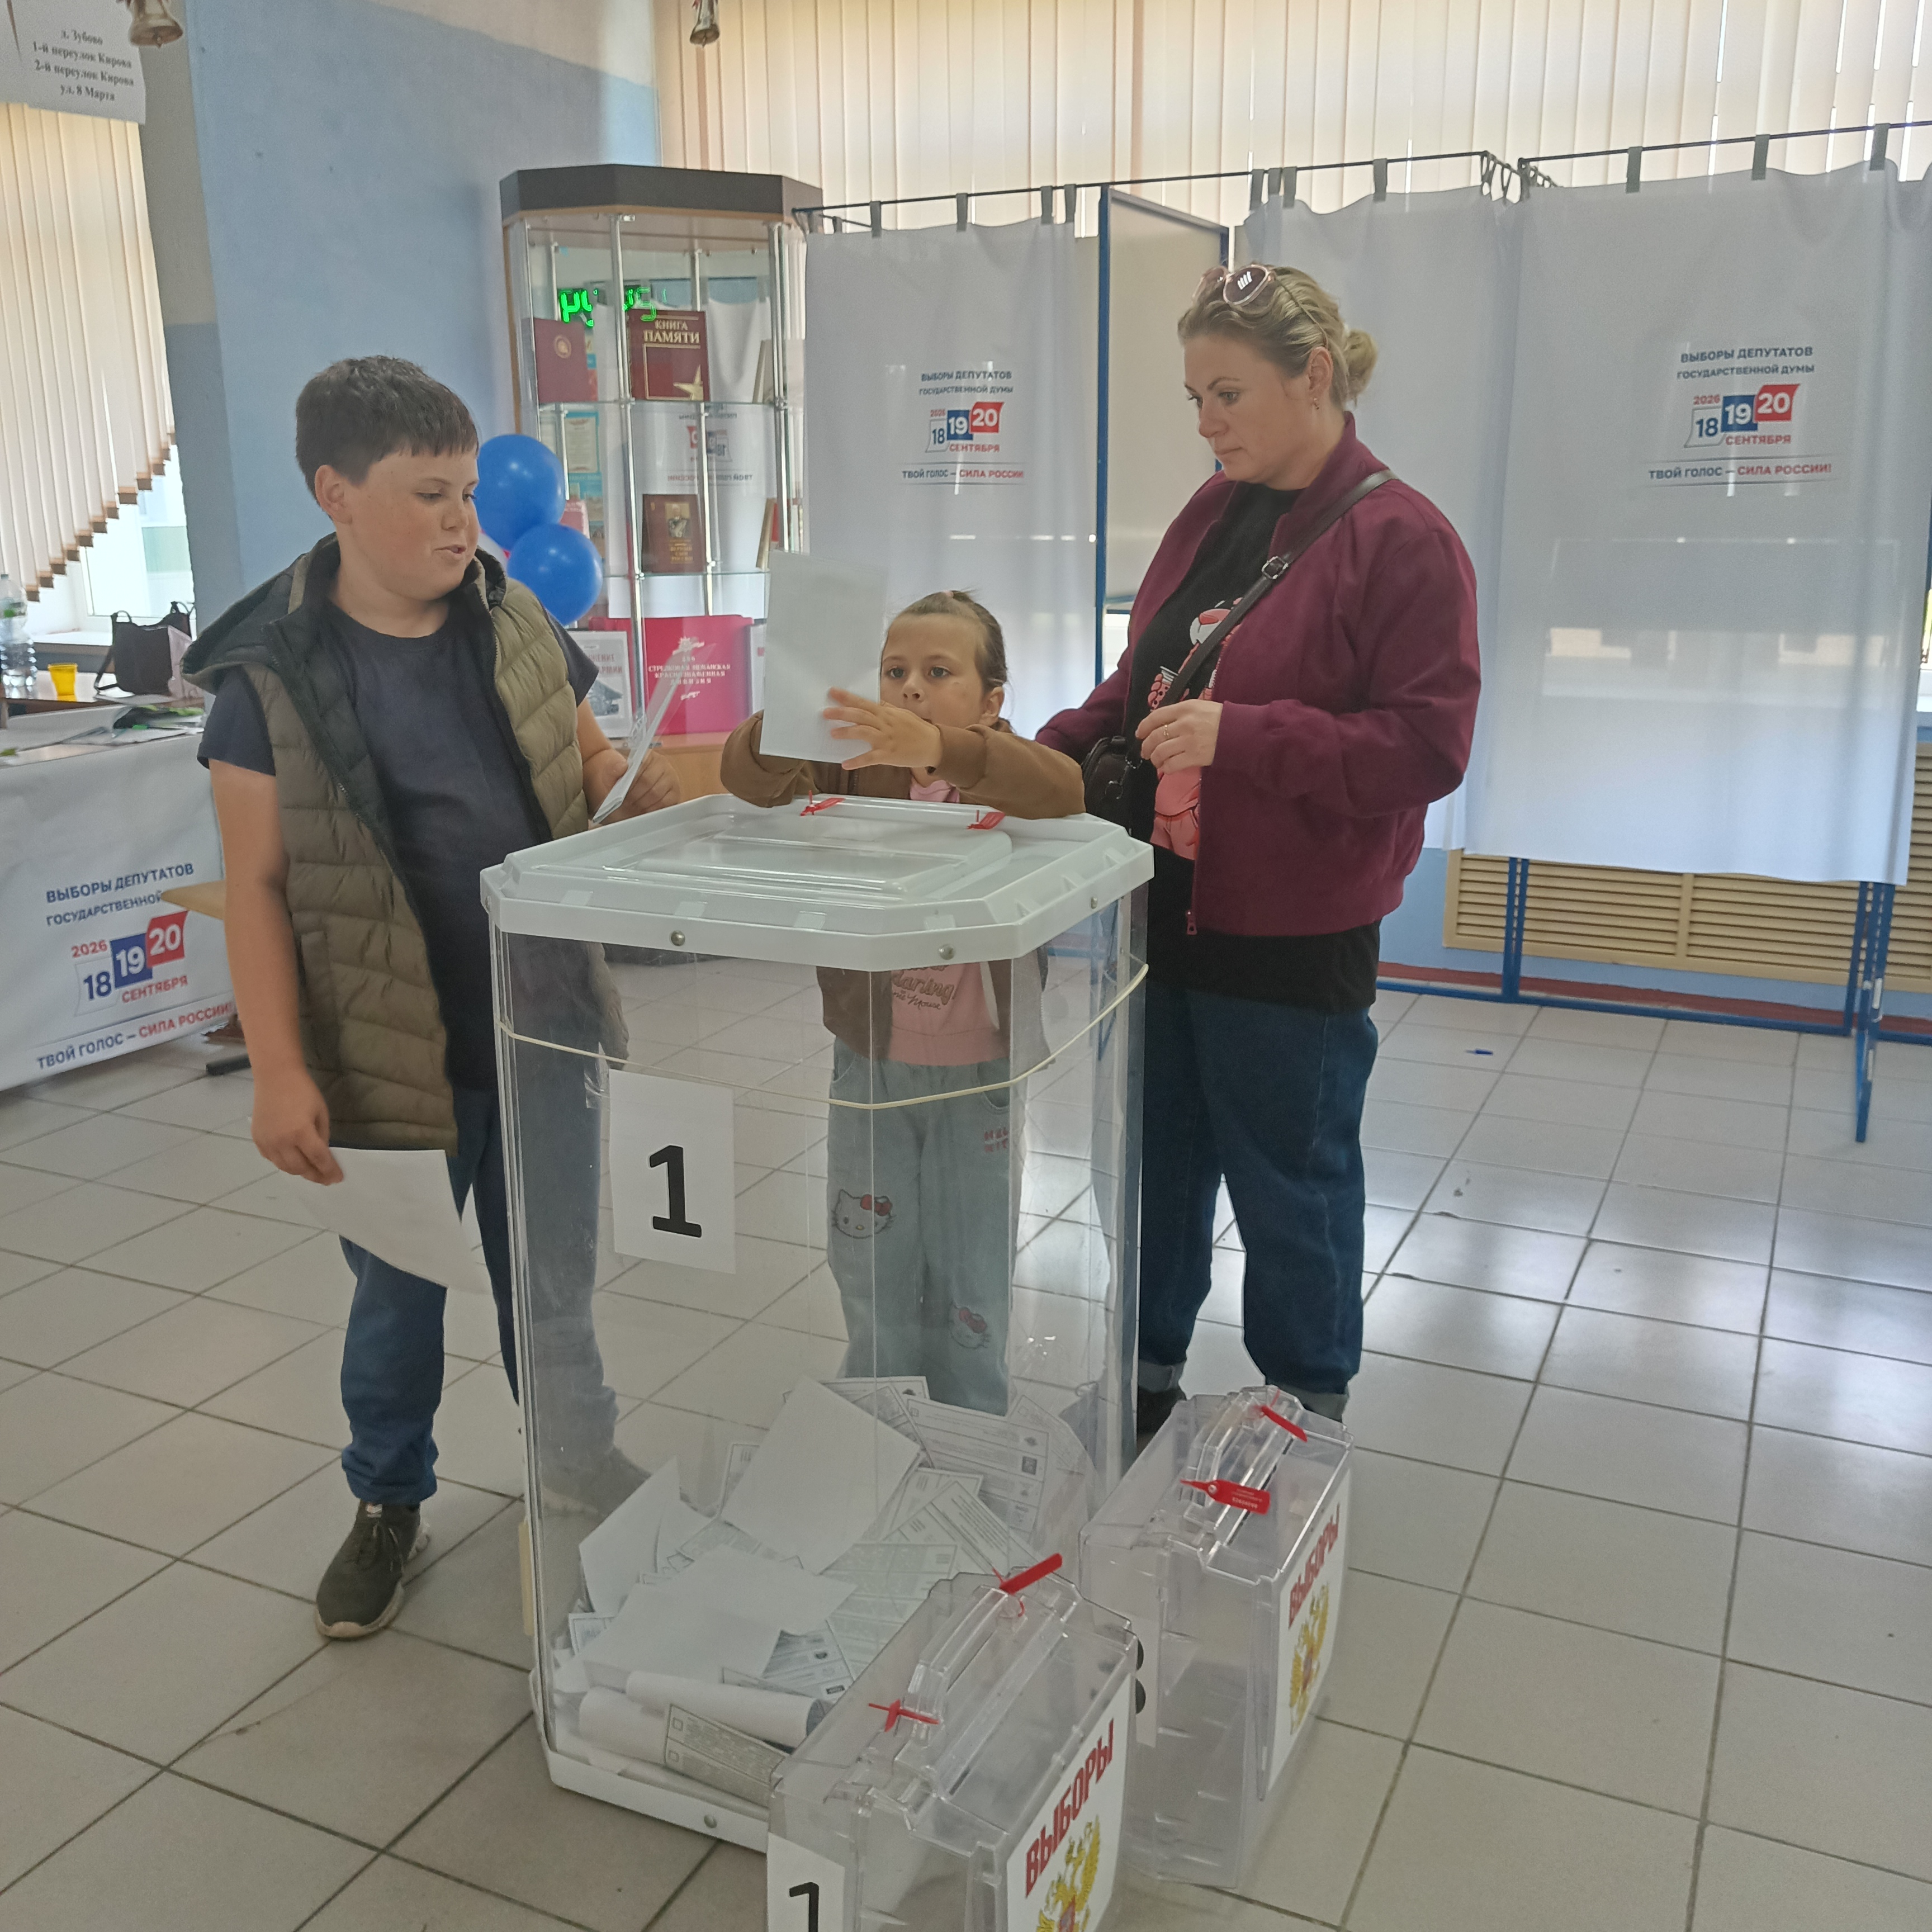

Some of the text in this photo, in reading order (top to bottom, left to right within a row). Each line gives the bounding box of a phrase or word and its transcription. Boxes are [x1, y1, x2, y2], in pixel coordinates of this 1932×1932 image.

[52, 46, 96, 61] переулок
[54, 65, 98, 79] переулок
[76, 84, 83, 96] 8
[85, 86, 115, 102] Марта
[655, 320, 688, 330] КНИГА
[643, 329, 700, 343] ПАМЯТИ
[1680, 346, 1813, 363] ВЫБОРЫ ДЕПУТАТОВ
[921, 371, 1012, 382] ВЫБОРЫ ДЕПУТАТОВ
[1677, 364, 1815, 380] ГОСУДАРСТВЕННОЙ ДУМЫ
[918, 386, 1014, 395] ГОСУДАРСТВЕННОЙ ДУМЫ
[1693, 394, 1721, 405] 2026
[1696, 392, 1790, 438] 18 19 20
[932, 408, 998, 445] 18 19 20
[949, 444, 1000, 453] СЕНТЯБРЯ
[1726, 435, 1792, 446] СЕНТЯБРЯ
[902, 468, 925, 479] ТВОЙ
[926, 468, 949, 478] ГОЛОС
[959, 469, 986, 477] СИЛА
[1649, 466, 1682, 480] ТВОЙ
[1684, 466, 1722, 478] ГОЛОС
[1737, 466, 1771, 476] СИЛА
[1774, 463, 1832, 475] РОССИИ!
[46, 863, 194, 904] ВЫБОРЫ ДЕПУТАТОВ
[72, 940, 107, 958] 2026
[83, 924, 182, 1001] 18 19 20
[122, 974, 188, 1004] СЕНТЯБРЯ
[907, 993, 941, 1010] Mouse
[37, 1046, 75, 1070] ТВОЙ
[79, 1032, 124, 1057] ГОЛОС
[139, 1018, 176, 1039] СИЛА
[649, 1145, 702, 1238] 1
[1288, 1502, 1340, 1631] ВЫБОРЫ
[1025, 1717, 1114, 1898] ВЫБОРЫ
[789, 1882, 820, 1932] 1
